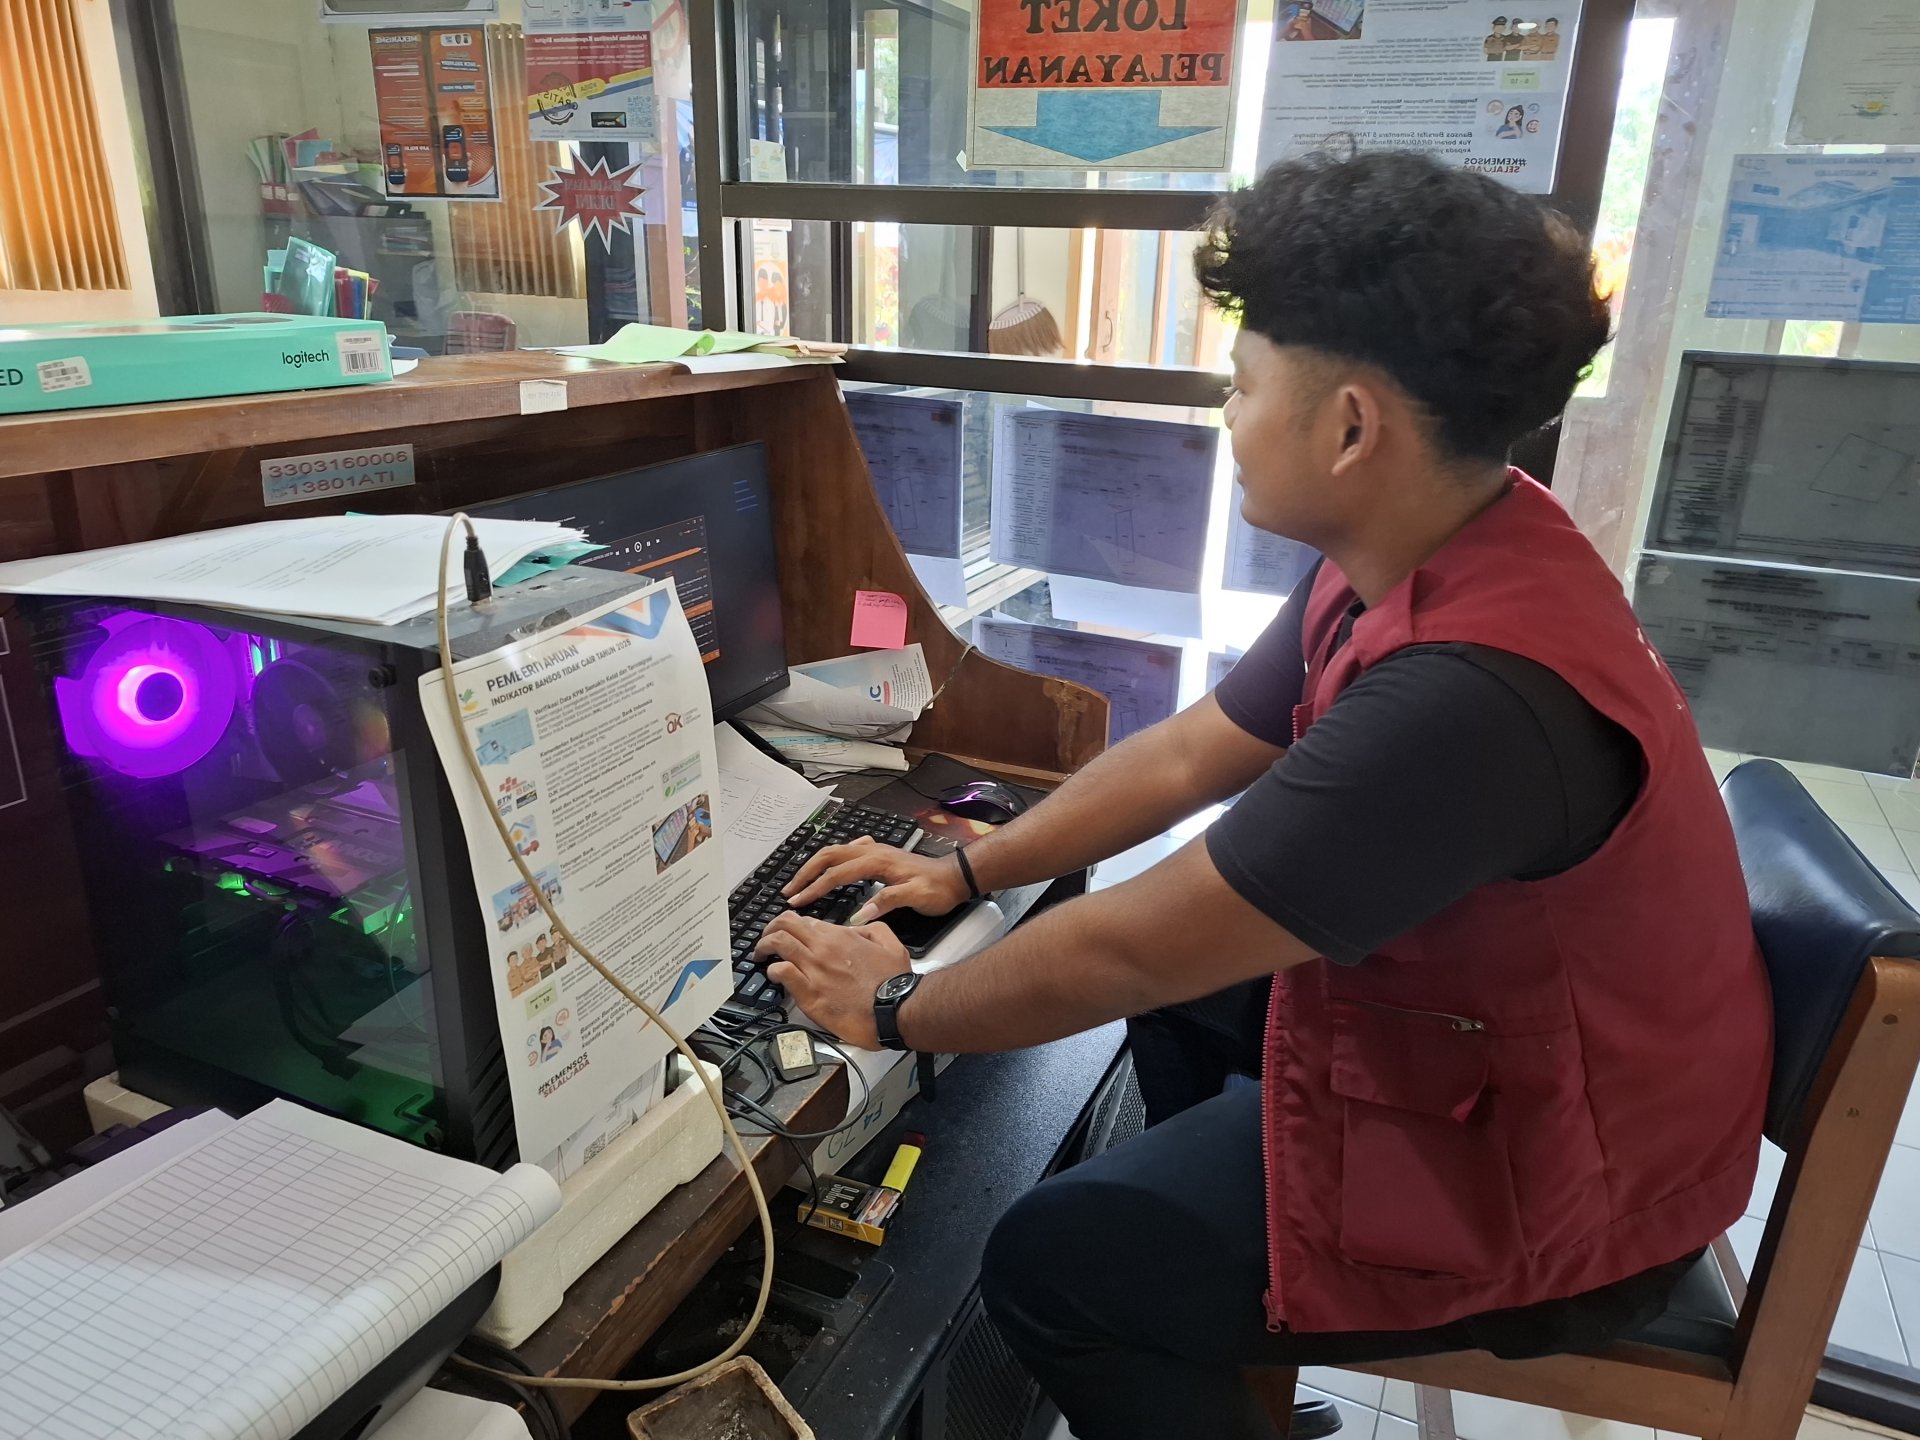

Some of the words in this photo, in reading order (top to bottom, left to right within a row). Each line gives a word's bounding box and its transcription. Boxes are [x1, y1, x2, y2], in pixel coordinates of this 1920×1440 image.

[282, 349, 330, 368] logitech
[268, 450, 409, 479] 3303160006
[288, 471, 395, 494] 13801ATI
[490, 683, 533, 706] INDIKATOR
[534, 670, 561, 688] BANSOS
[561, 661, 580, 675] TIDAK
[580, 654, 595, 667] CAIR
[596, 645, 616, 659] TAHUN
[615, 638, 631, 650] 2025
[496, 794, 511, 805] BTN
[538, 1052, 588, 1095] #KEMENSOS
